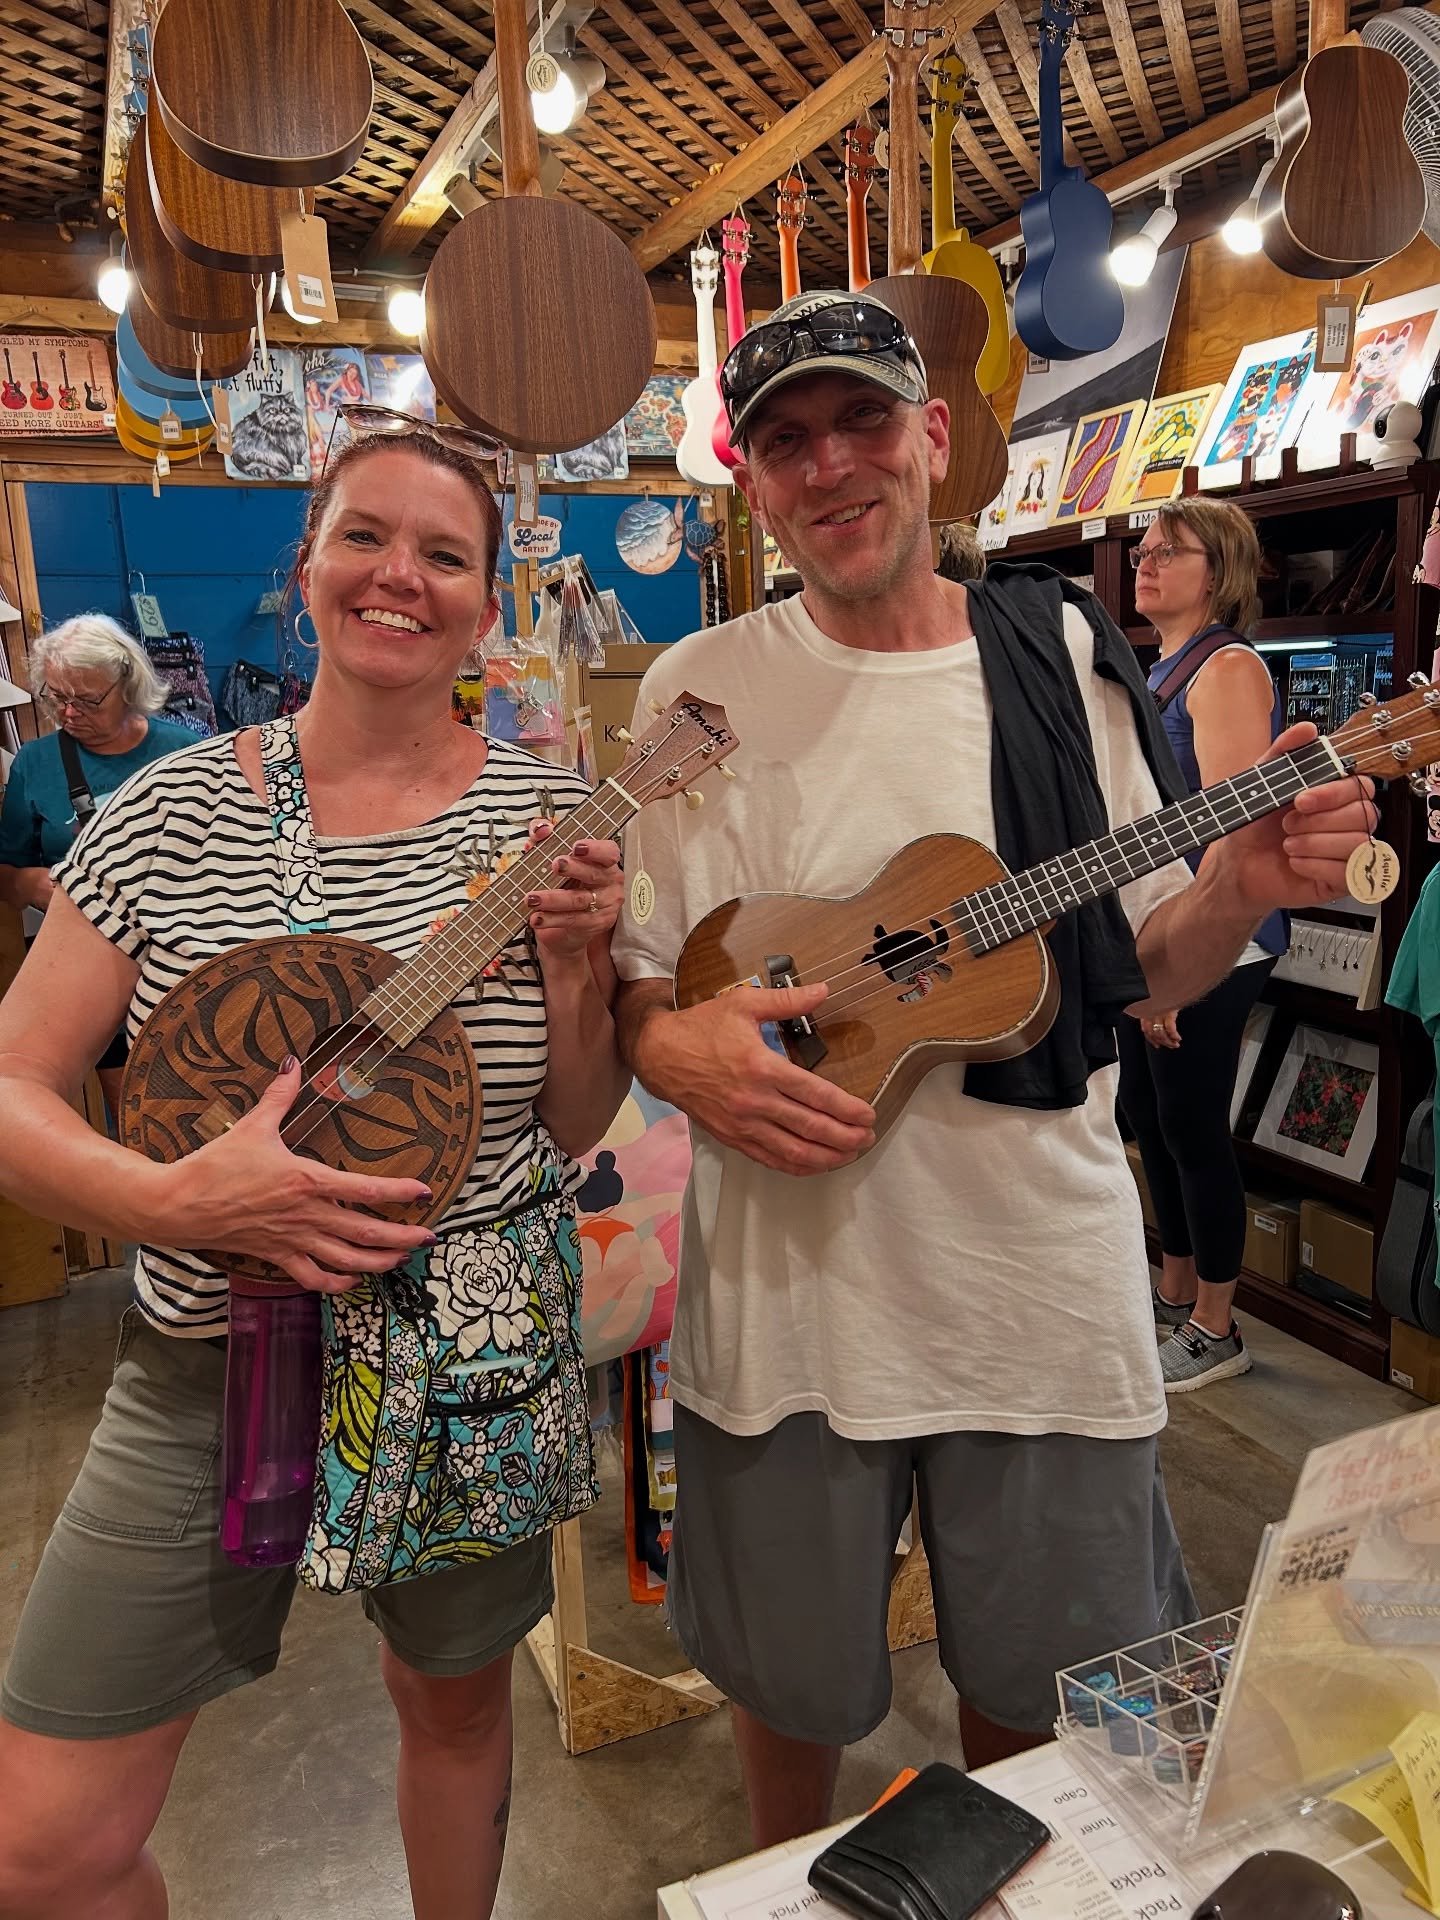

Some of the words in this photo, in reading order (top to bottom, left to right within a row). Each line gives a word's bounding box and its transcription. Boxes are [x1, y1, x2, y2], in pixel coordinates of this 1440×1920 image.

[0, 338, 25, 346] GLED
[28, 338, 41, 347] MY
[44, 338, 90, 348] SYMPTOMS
[244, 371, 283, 394] fluffy
[0, 419, 20, 428] EED
[24, 419, 52, 428] MORE
[2, 411, 34, 419] TURNED
[37, 411, 53, 420] OUT
[63, 412, 84, 420] JUST
[513, 527, 554, 547] Local
[522, 546, 550, 554] ARTIST
[680, 701, 733, 747] Amahi
[1053, 1787, 1088, 1805] Capo
[1080, 1816, 1119, 1836] Tuner
[768, 1901, 801, 1920] Pick
